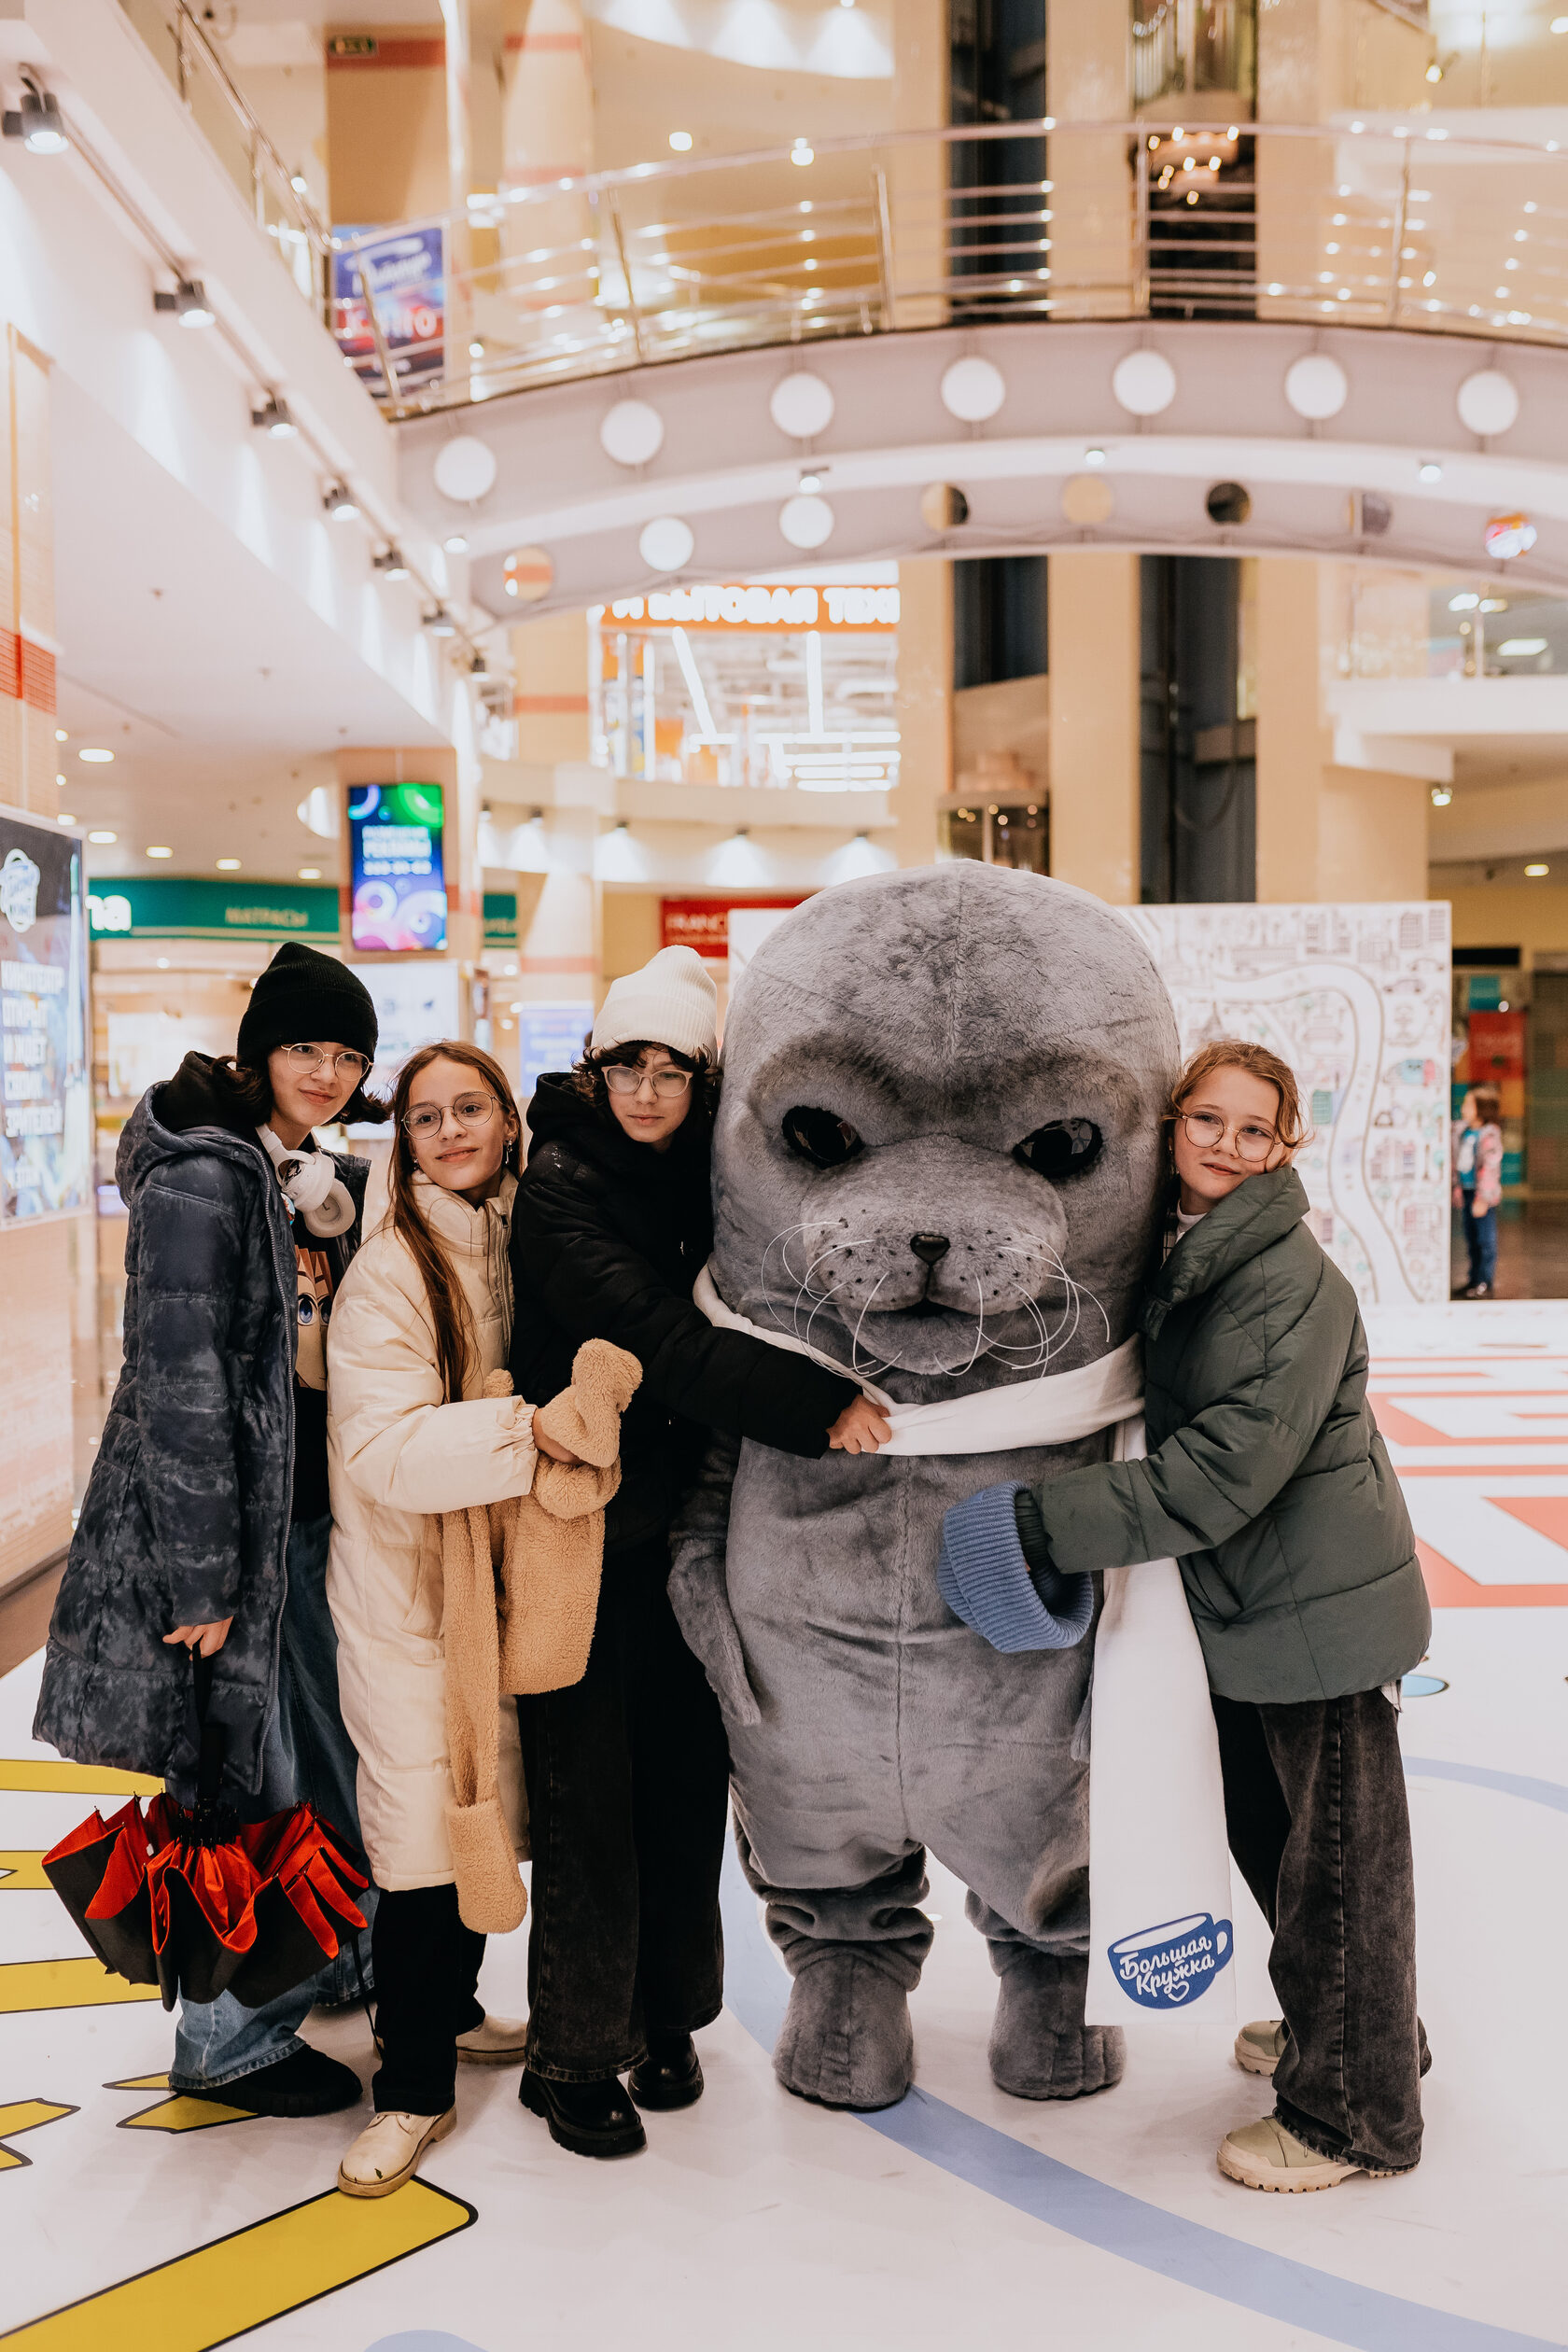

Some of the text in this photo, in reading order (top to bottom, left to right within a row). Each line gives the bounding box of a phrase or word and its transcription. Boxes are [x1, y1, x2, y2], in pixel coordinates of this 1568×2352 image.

[648, 585, 819, 623] БЫТОВАЯ
[224, 907, 309, 928] МАТРАСЫ
[1, 960, 65, 995] КИНОТЕАТР
[2, 997, 48, 1028] ОТКРЫТ
[6, 1099, 63, 1137] ЗРИТЕЛЕЙ
[322, 1201, 330, 1211] L
[1119, 1936, 1212, 1981] Большая
[1136, 1953, 1215, 1997] Кружка
